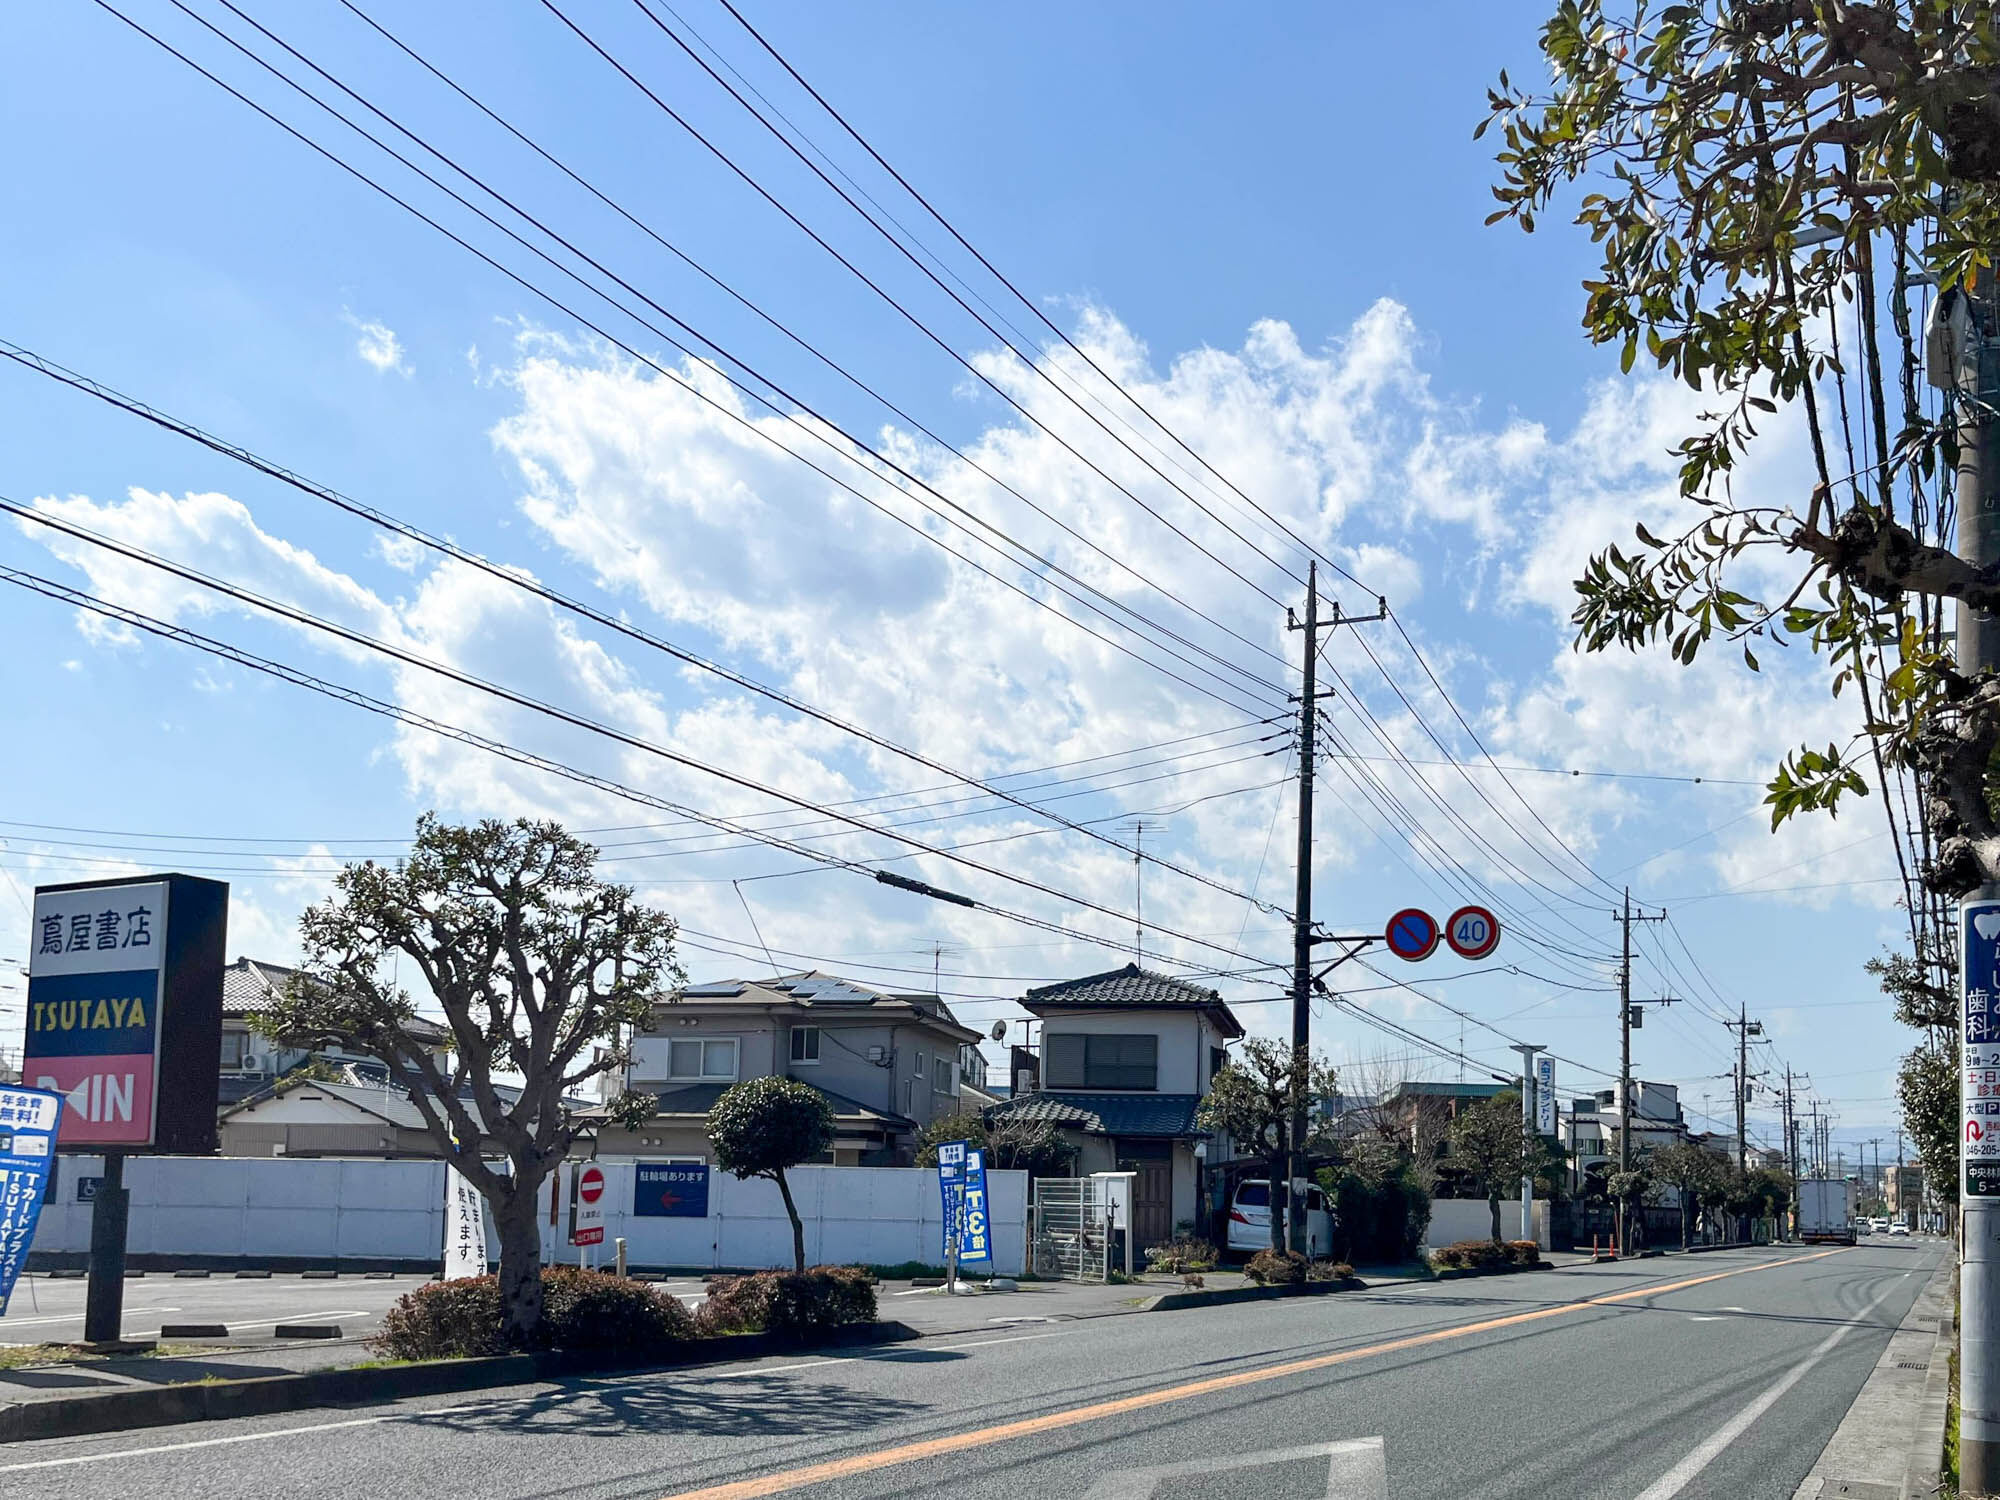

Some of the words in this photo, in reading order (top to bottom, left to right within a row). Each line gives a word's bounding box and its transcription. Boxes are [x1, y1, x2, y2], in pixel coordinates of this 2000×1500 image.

[39, 906, 152, 954] 蔦屋書店
[1457, 920, 1486, 943] 40
[33, 998, 146, 1032] TSUTAYA
[1967, 987, 1990, 1040] 歯科
[90, 1073, 135, 1122] IN
